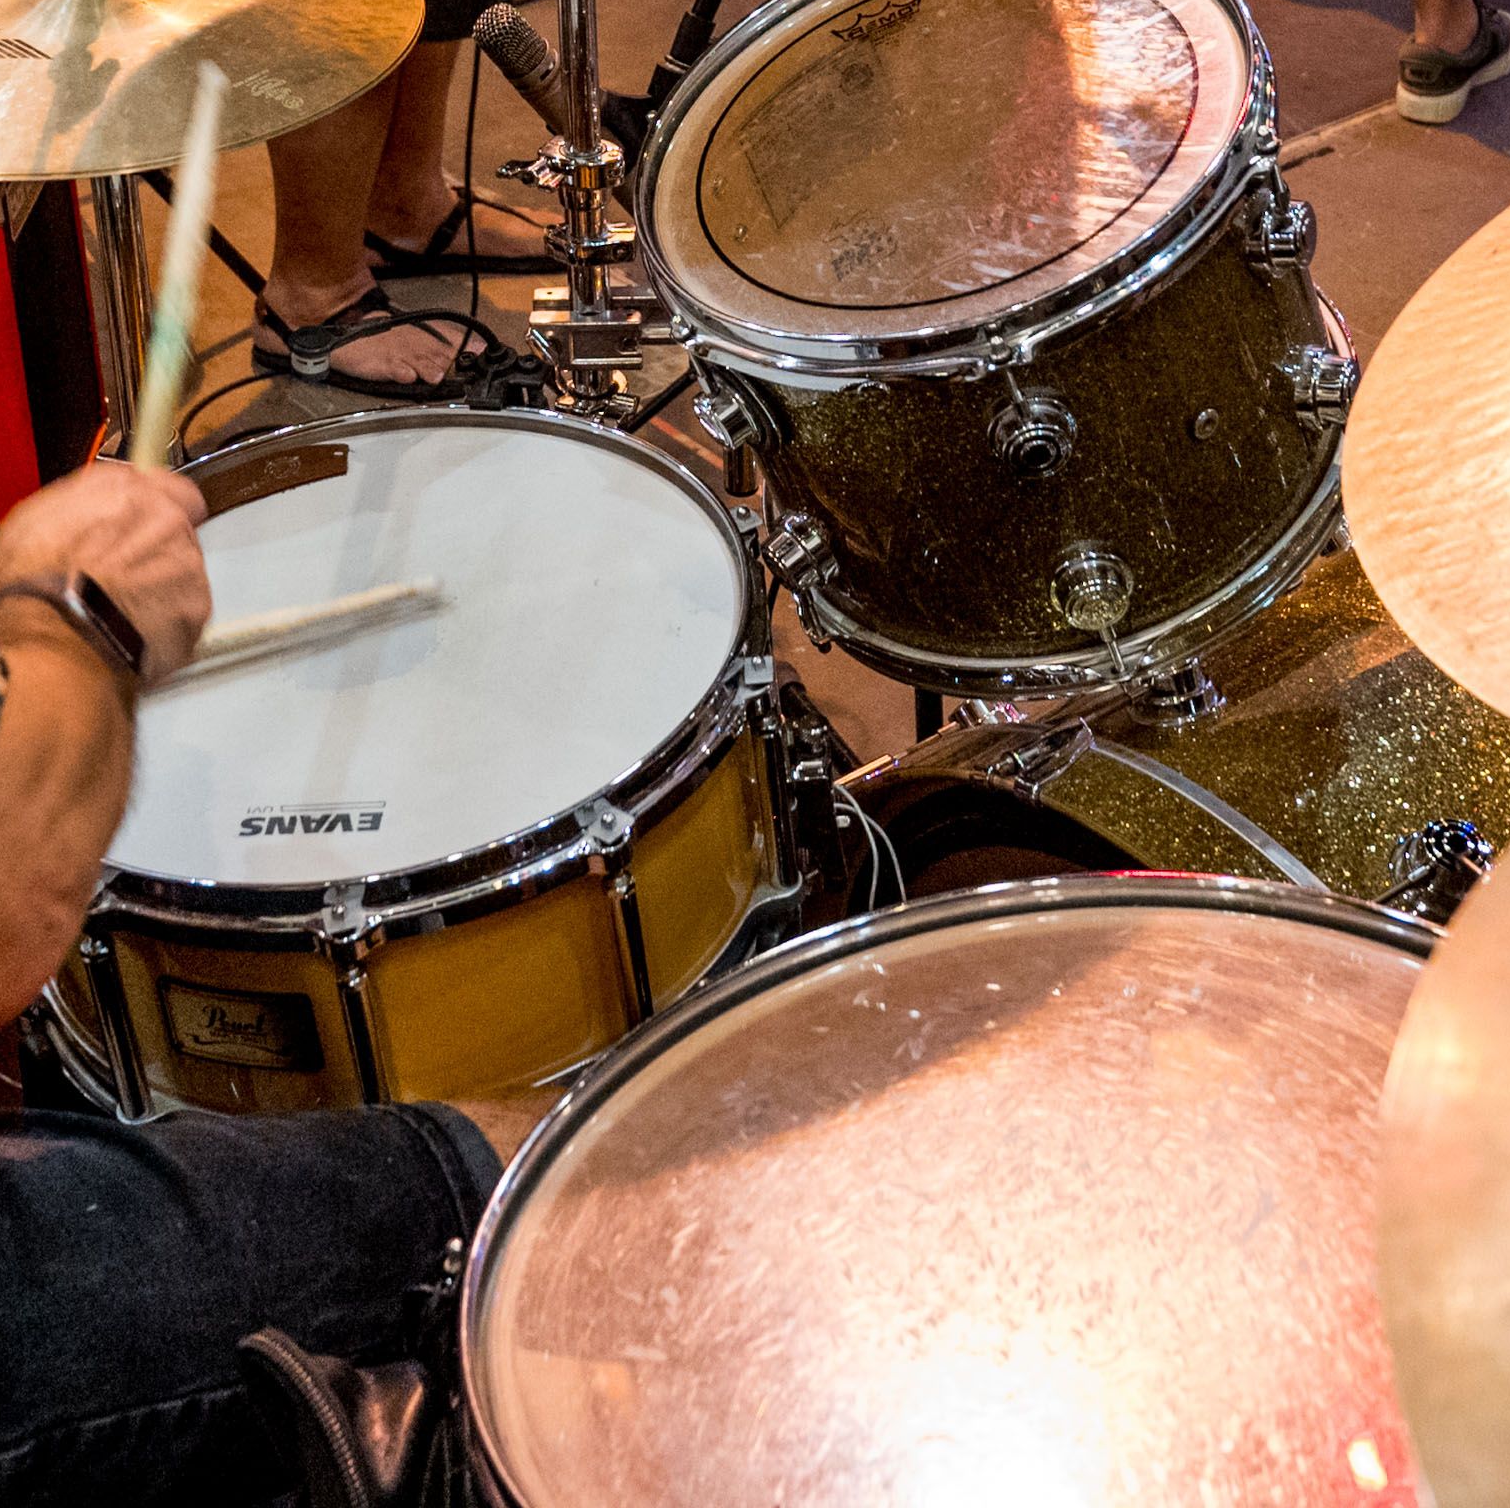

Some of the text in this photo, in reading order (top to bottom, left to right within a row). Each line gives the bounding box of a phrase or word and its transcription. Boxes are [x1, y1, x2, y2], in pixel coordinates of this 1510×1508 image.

[847, 7, 915, 40] REMO
[239, 811, 384, 837] EVANS
[202, 1004, 267, 1033] Pearl
